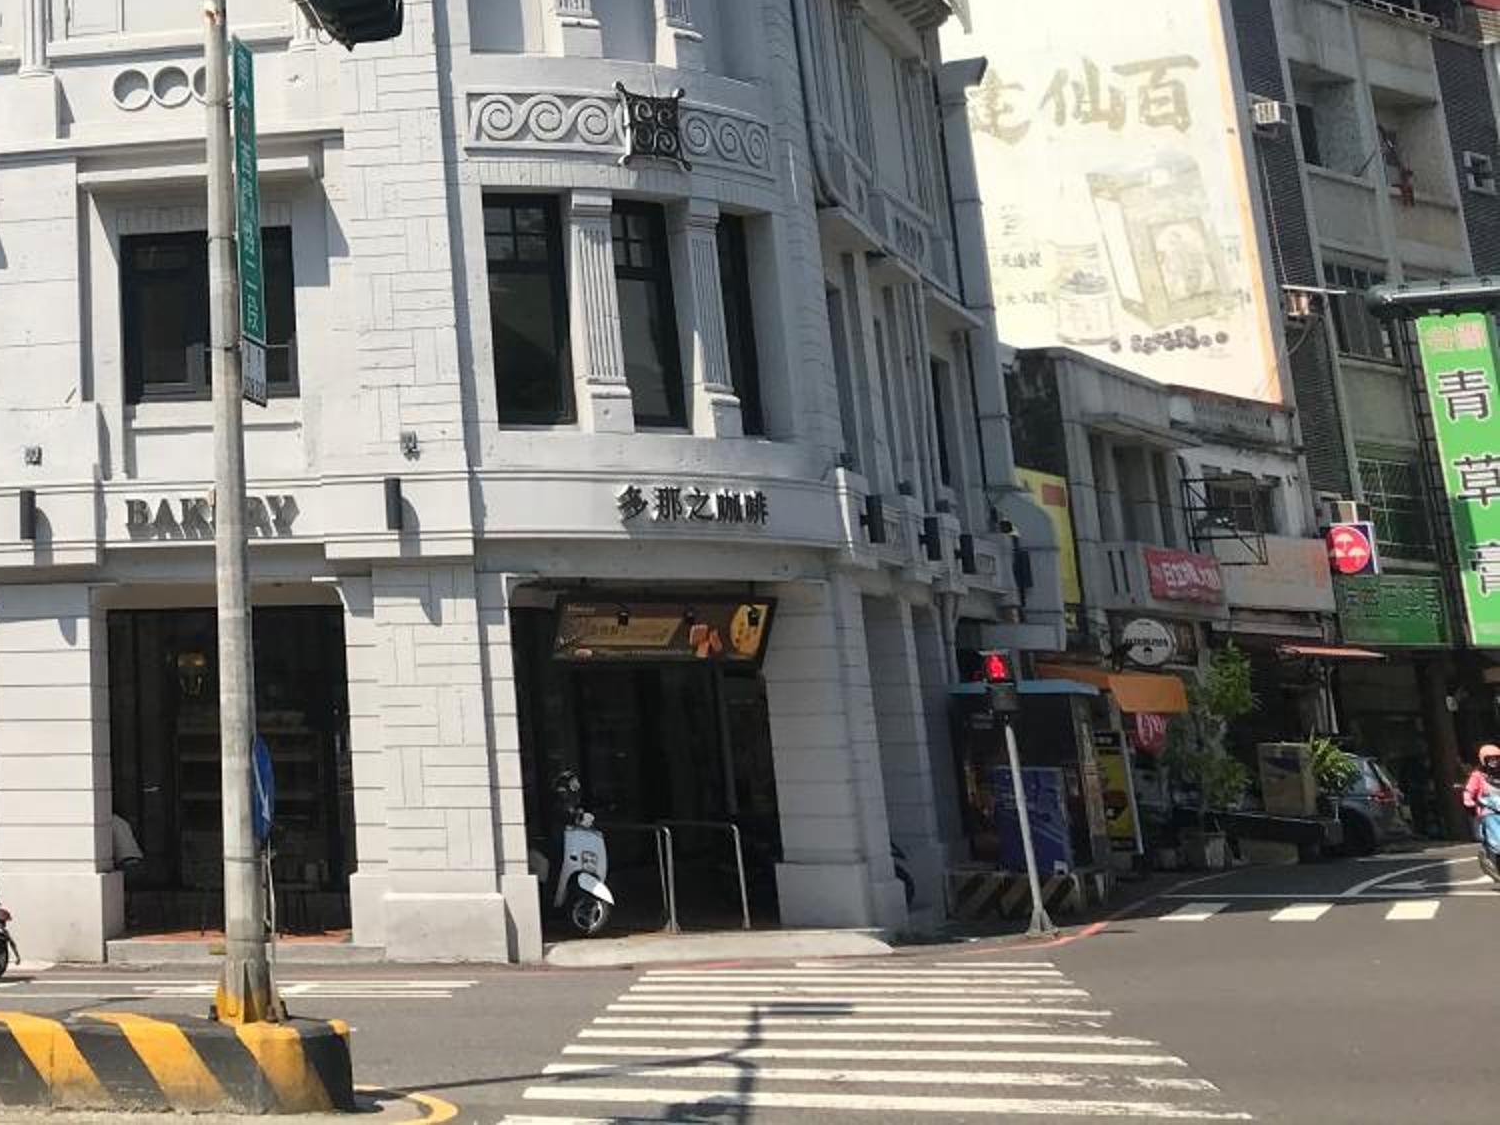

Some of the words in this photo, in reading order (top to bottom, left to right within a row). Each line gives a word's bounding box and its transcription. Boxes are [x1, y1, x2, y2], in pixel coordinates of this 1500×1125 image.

[125, 495, 299, 531] BAKRY
[616, 485, 770, 525] 多那之咖啡
